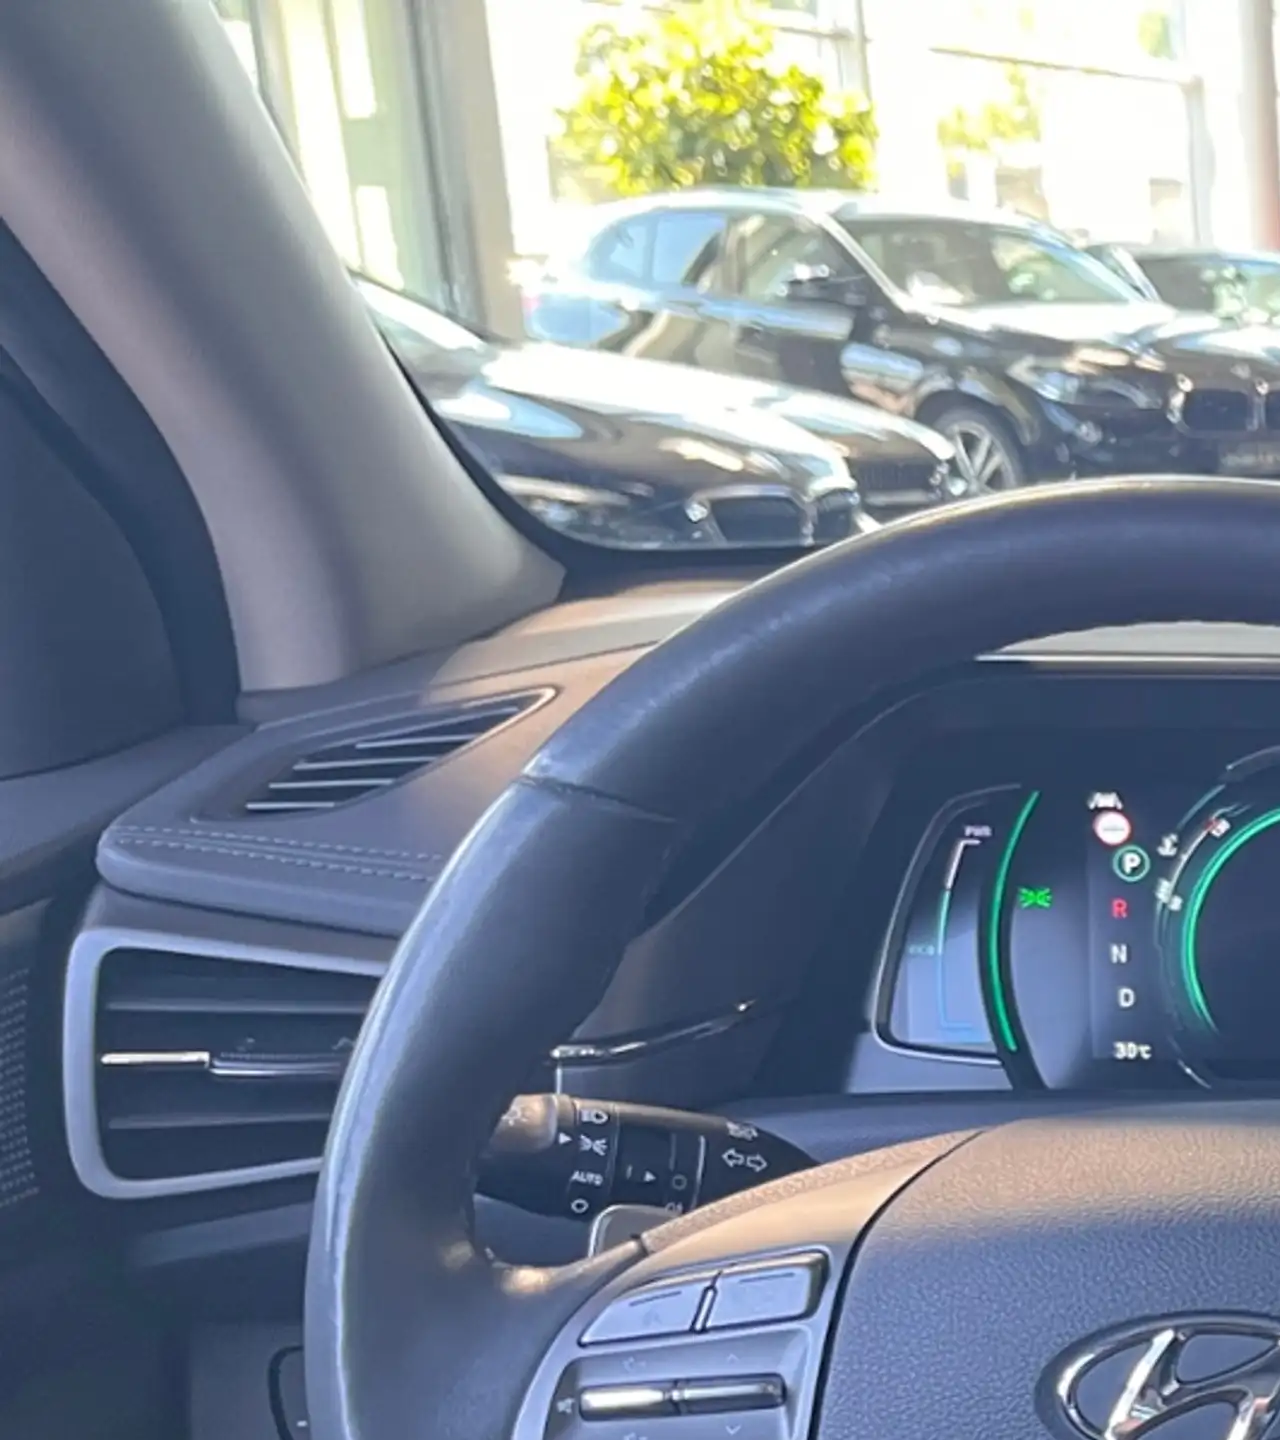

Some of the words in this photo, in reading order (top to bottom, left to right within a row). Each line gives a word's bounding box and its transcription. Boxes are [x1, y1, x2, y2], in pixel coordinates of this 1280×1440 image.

[1122, 852, 1141, 875] P
[1111, 898, 1128, 918] R
[1110, 944, 1128, 963] N
[1118, 987, 1136, 1008] D
[570, 1169, 603, 1185] AUTO
